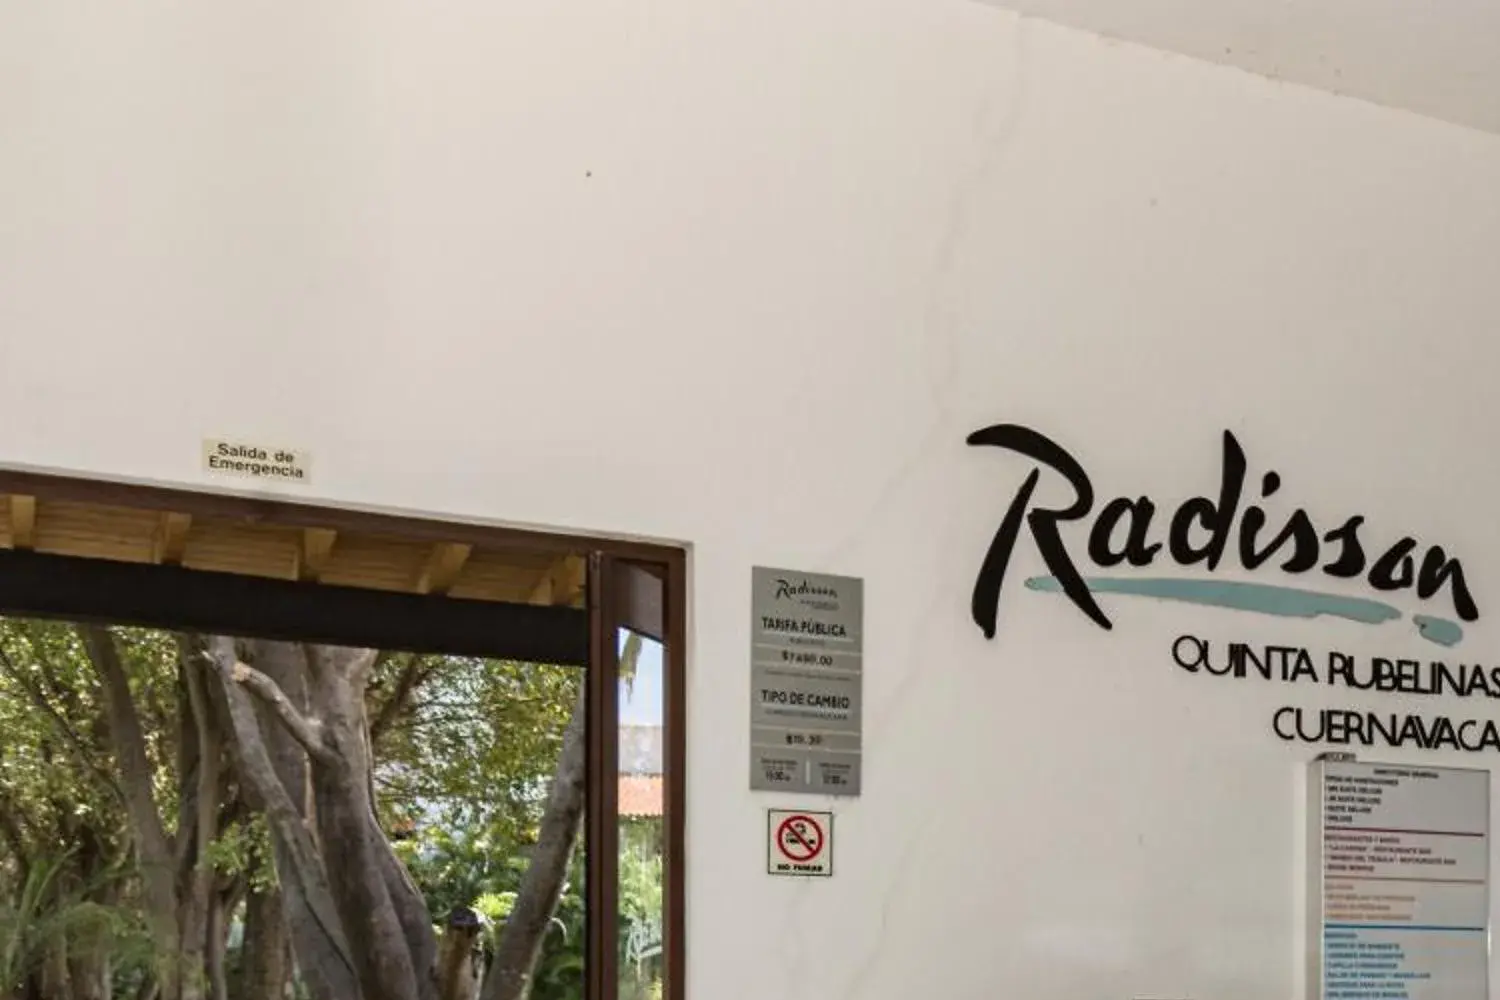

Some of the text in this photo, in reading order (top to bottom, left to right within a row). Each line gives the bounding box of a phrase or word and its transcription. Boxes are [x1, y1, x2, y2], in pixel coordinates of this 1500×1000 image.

[208, 455, 304, 478] Emergencia
[217, 443, 294, 463] Salida de
[966, 423, 1479, 639] Radisson
[1172, 635, 1318, 684] QUINTA
